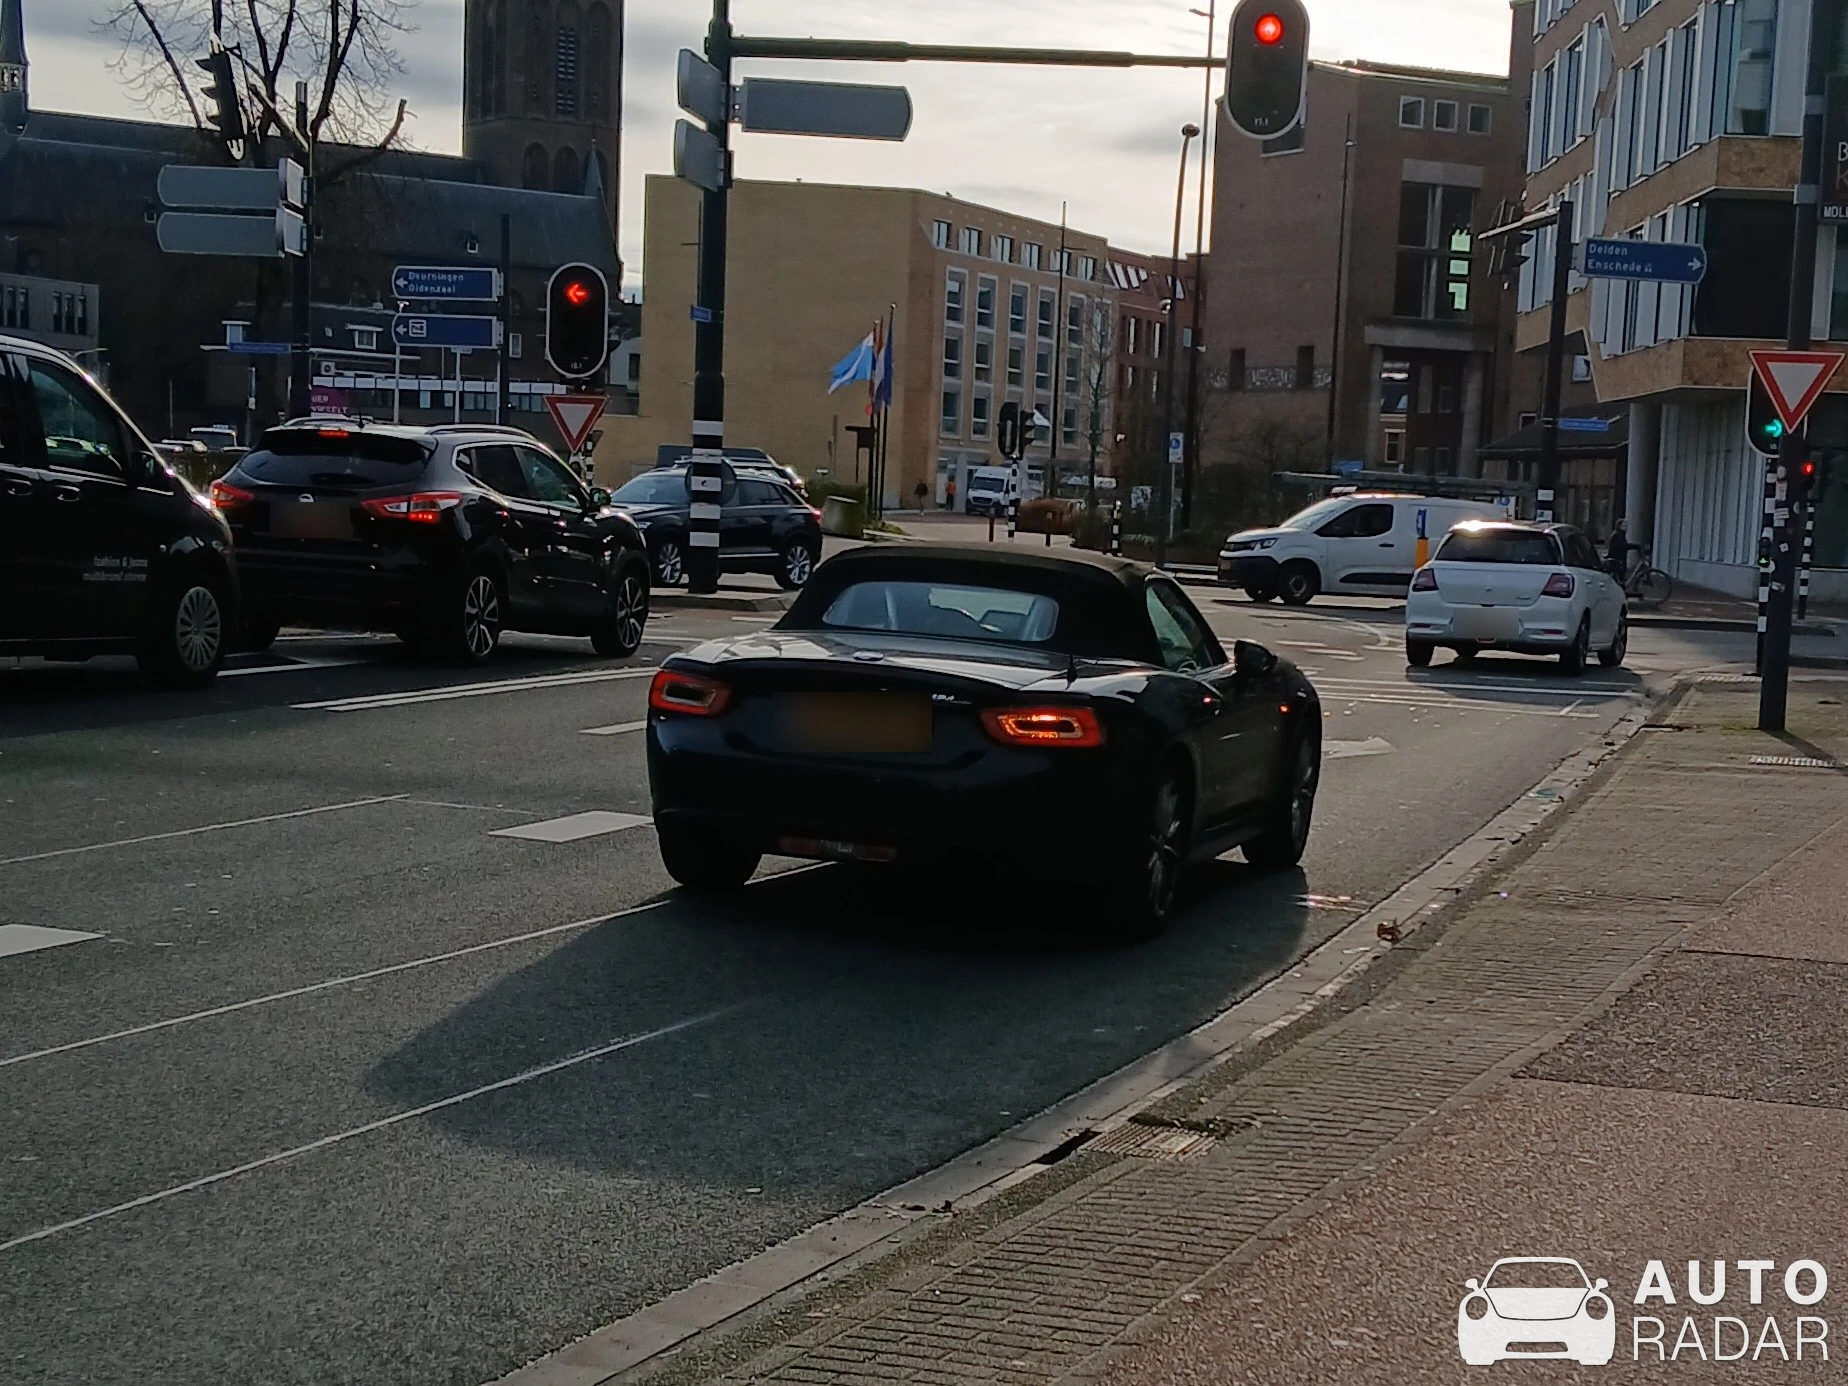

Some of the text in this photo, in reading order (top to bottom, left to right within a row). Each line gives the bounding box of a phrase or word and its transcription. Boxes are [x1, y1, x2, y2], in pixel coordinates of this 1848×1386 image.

[1589, 243, 1628, 255] Delden
[1587, 259, 1642, 272] Enschede
[408, 271, 464, 282] Deurningen
[408, 284, 456, 294] Oldenzaal
